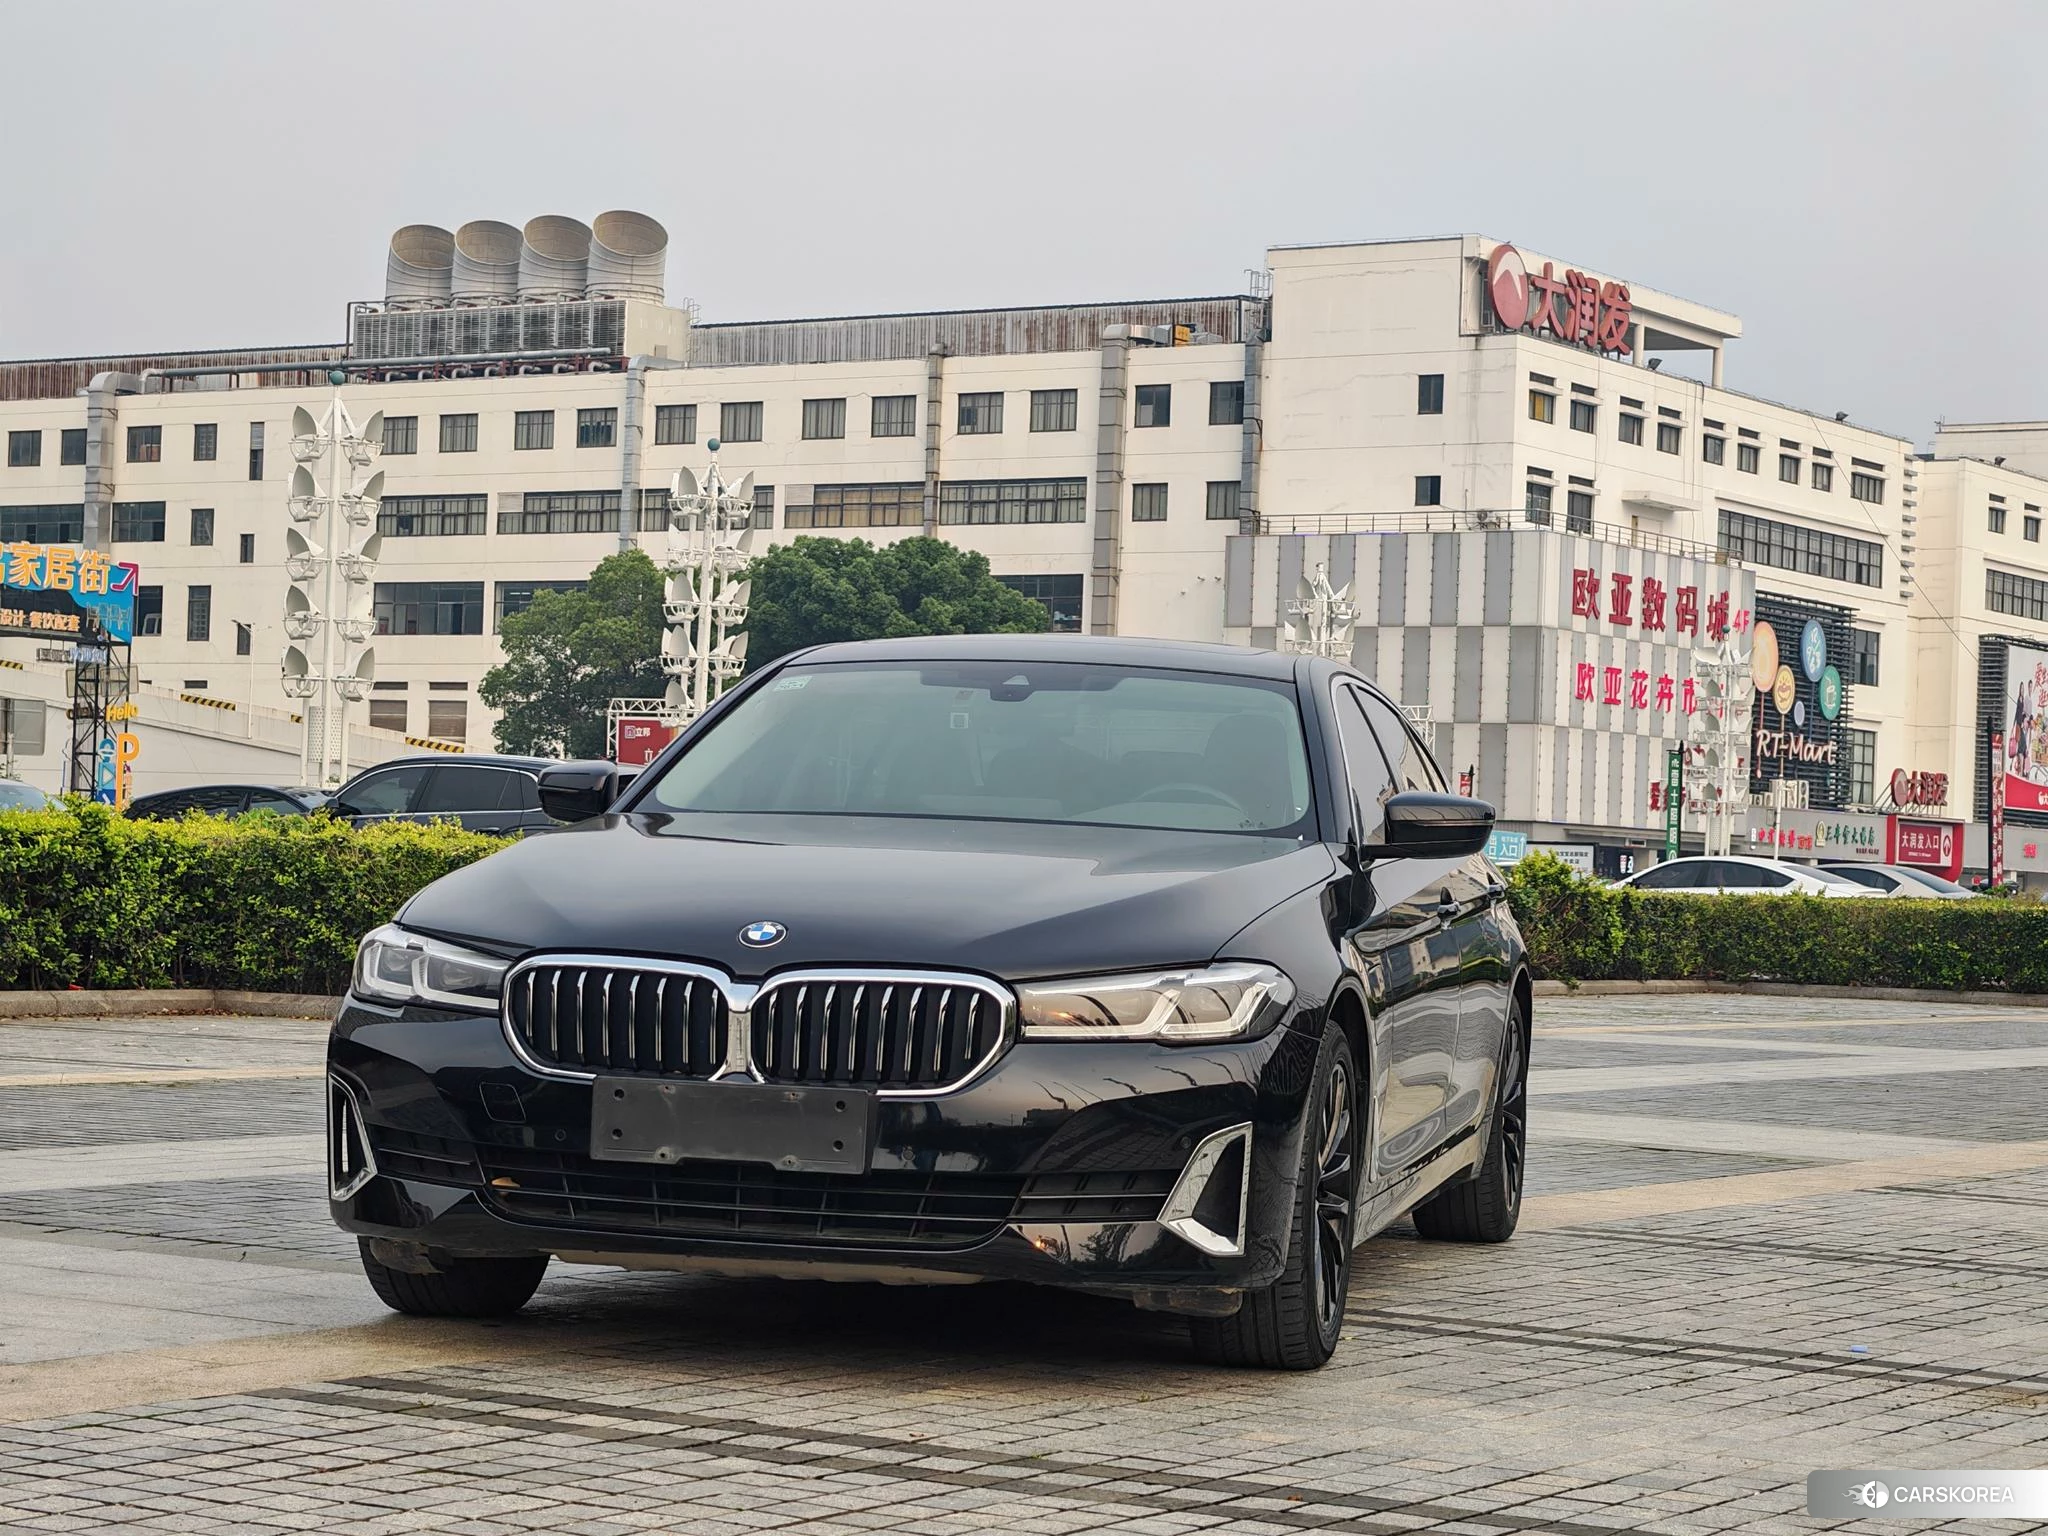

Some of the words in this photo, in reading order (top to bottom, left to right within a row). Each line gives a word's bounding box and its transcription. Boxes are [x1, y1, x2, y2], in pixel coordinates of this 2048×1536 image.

[1529, 262, 1632, 355] 大润发
[0, 541, 110, 595] 家居街
[1572, 568, 1729, 642] 欧亚数码城
[1575, 663, 1723, 718] 欧亚花卉市
[105, 702, 138, 721] Hello
[1756, 729, 1837, 766] RT-Mart
[1908, 771, 1949, 806] 大润发
[1500, 843, 1517, 856] 入口
[1902, 831, 1939, 849] 大润发入口
